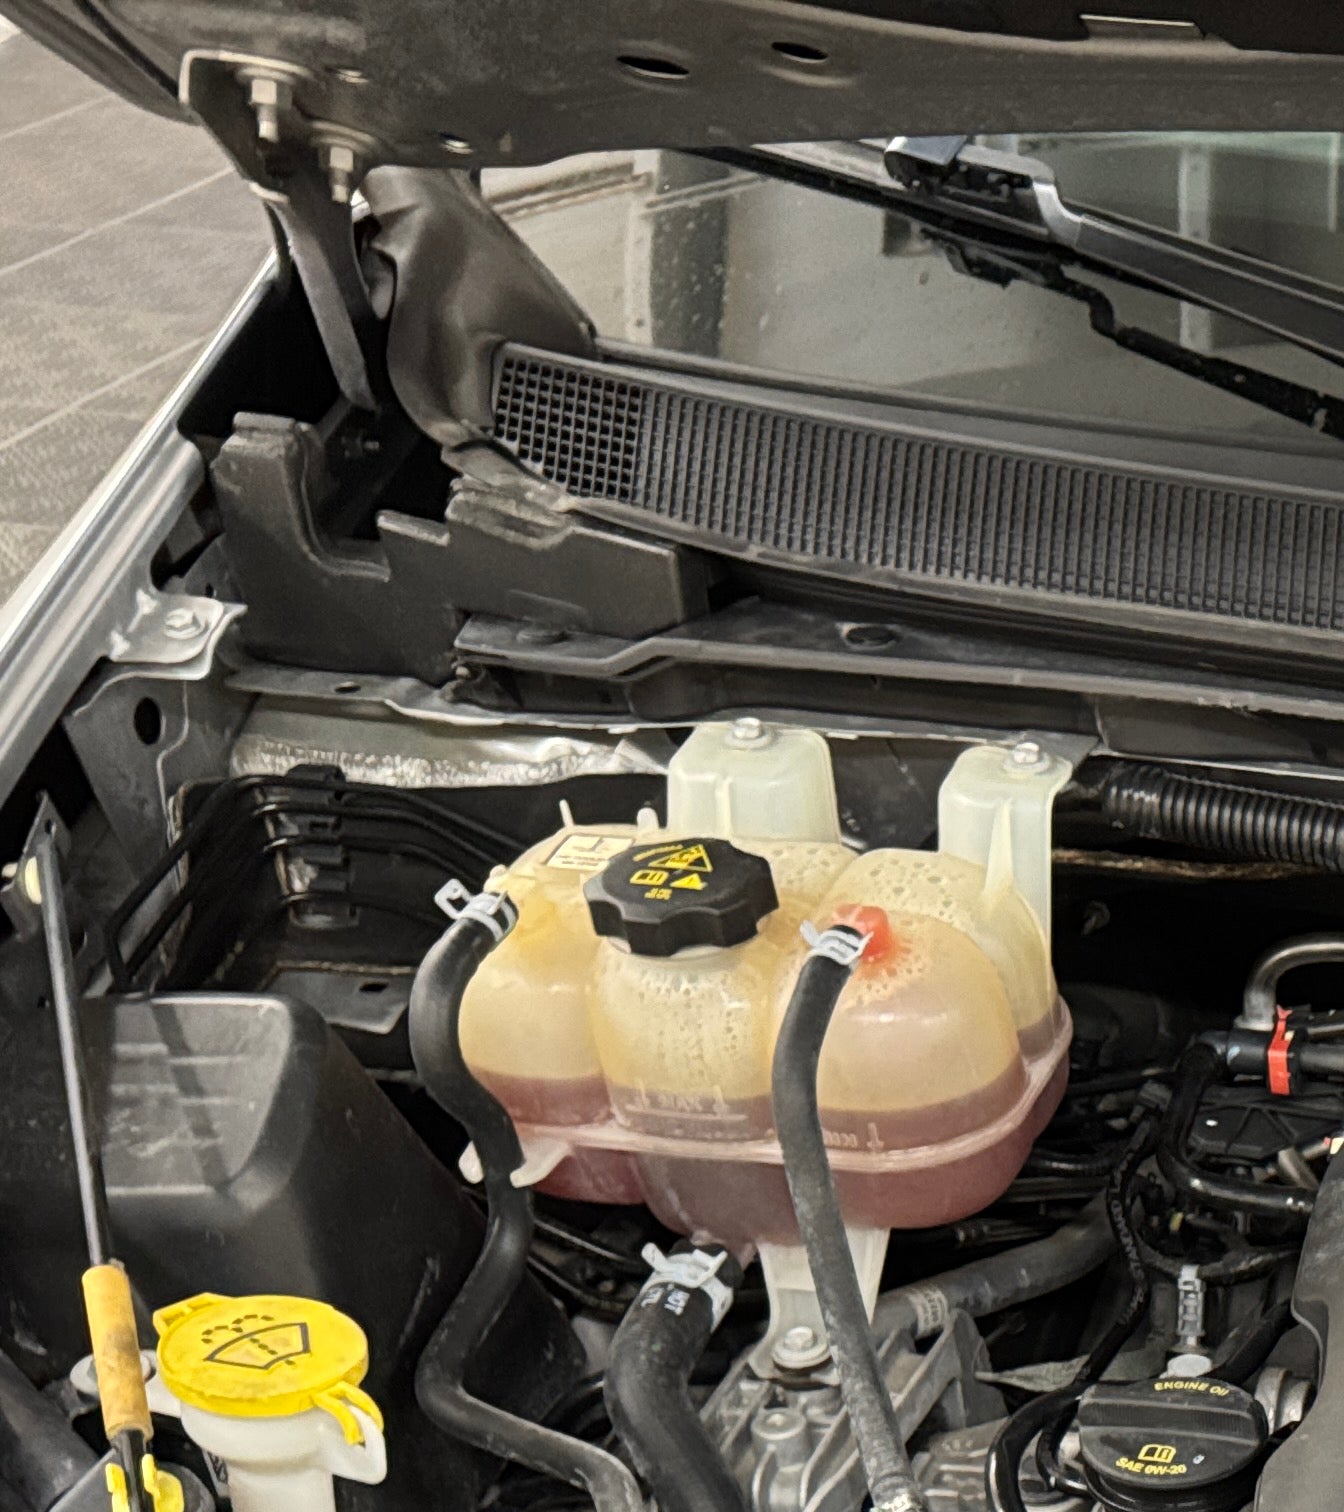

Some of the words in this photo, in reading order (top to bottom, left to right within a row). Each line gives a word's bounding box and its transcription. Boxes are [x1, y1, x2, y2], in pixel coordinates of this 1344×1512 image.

[1154, 1380, 1209, 1393] ENGINE
[1115, 1456, 1146, 1474] SAE
[1144, 1462, 1188, 1476] 0W-20
